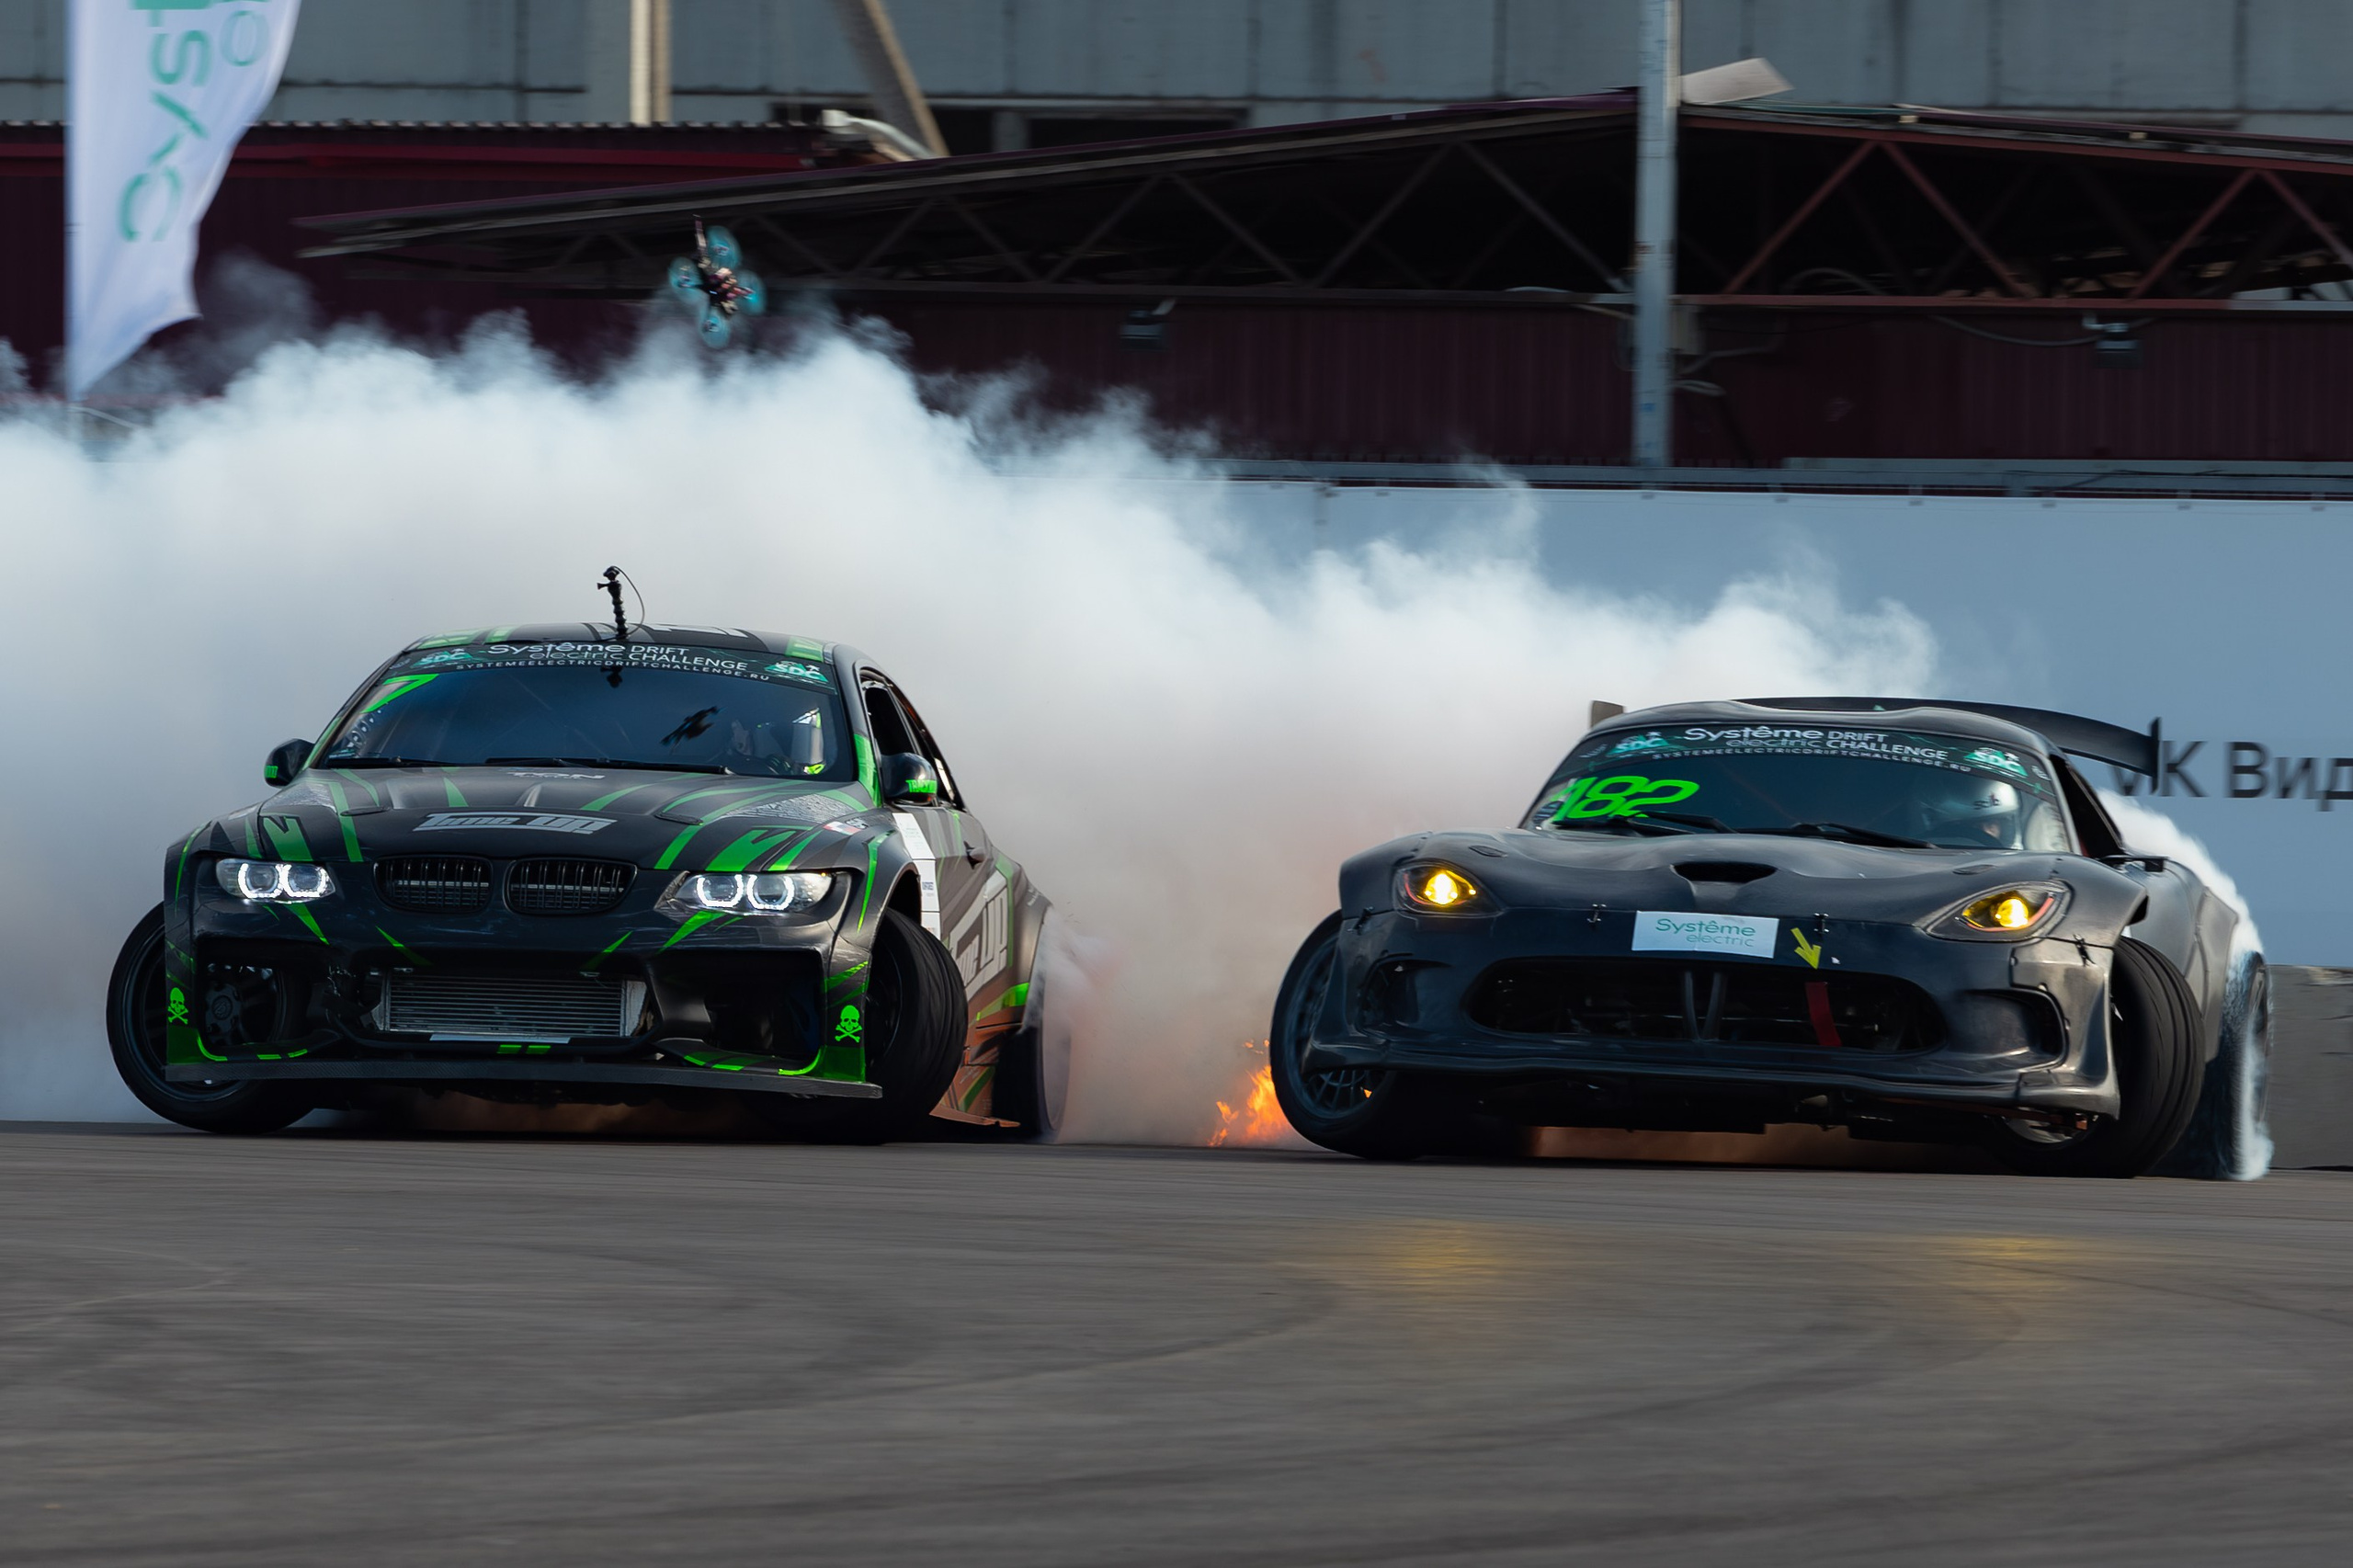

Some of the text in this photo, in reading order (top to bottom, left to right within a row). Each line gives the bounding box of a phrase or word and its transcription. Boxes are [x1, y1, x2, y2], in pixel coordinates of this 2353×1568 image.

[487, 642, 689, 655] Systême DRIFT
[529, 651, 748, 671] electric CHALLENGE
[1684, 726, 1888, 743] Systême DRIFT
[1725, 737, 1949, 760] electric CHALLENGE
[1552, 776, 1699, 822] 182
[1655, 918, 1756, 937] Systême
[1686, 932, 1755, 947] electric
